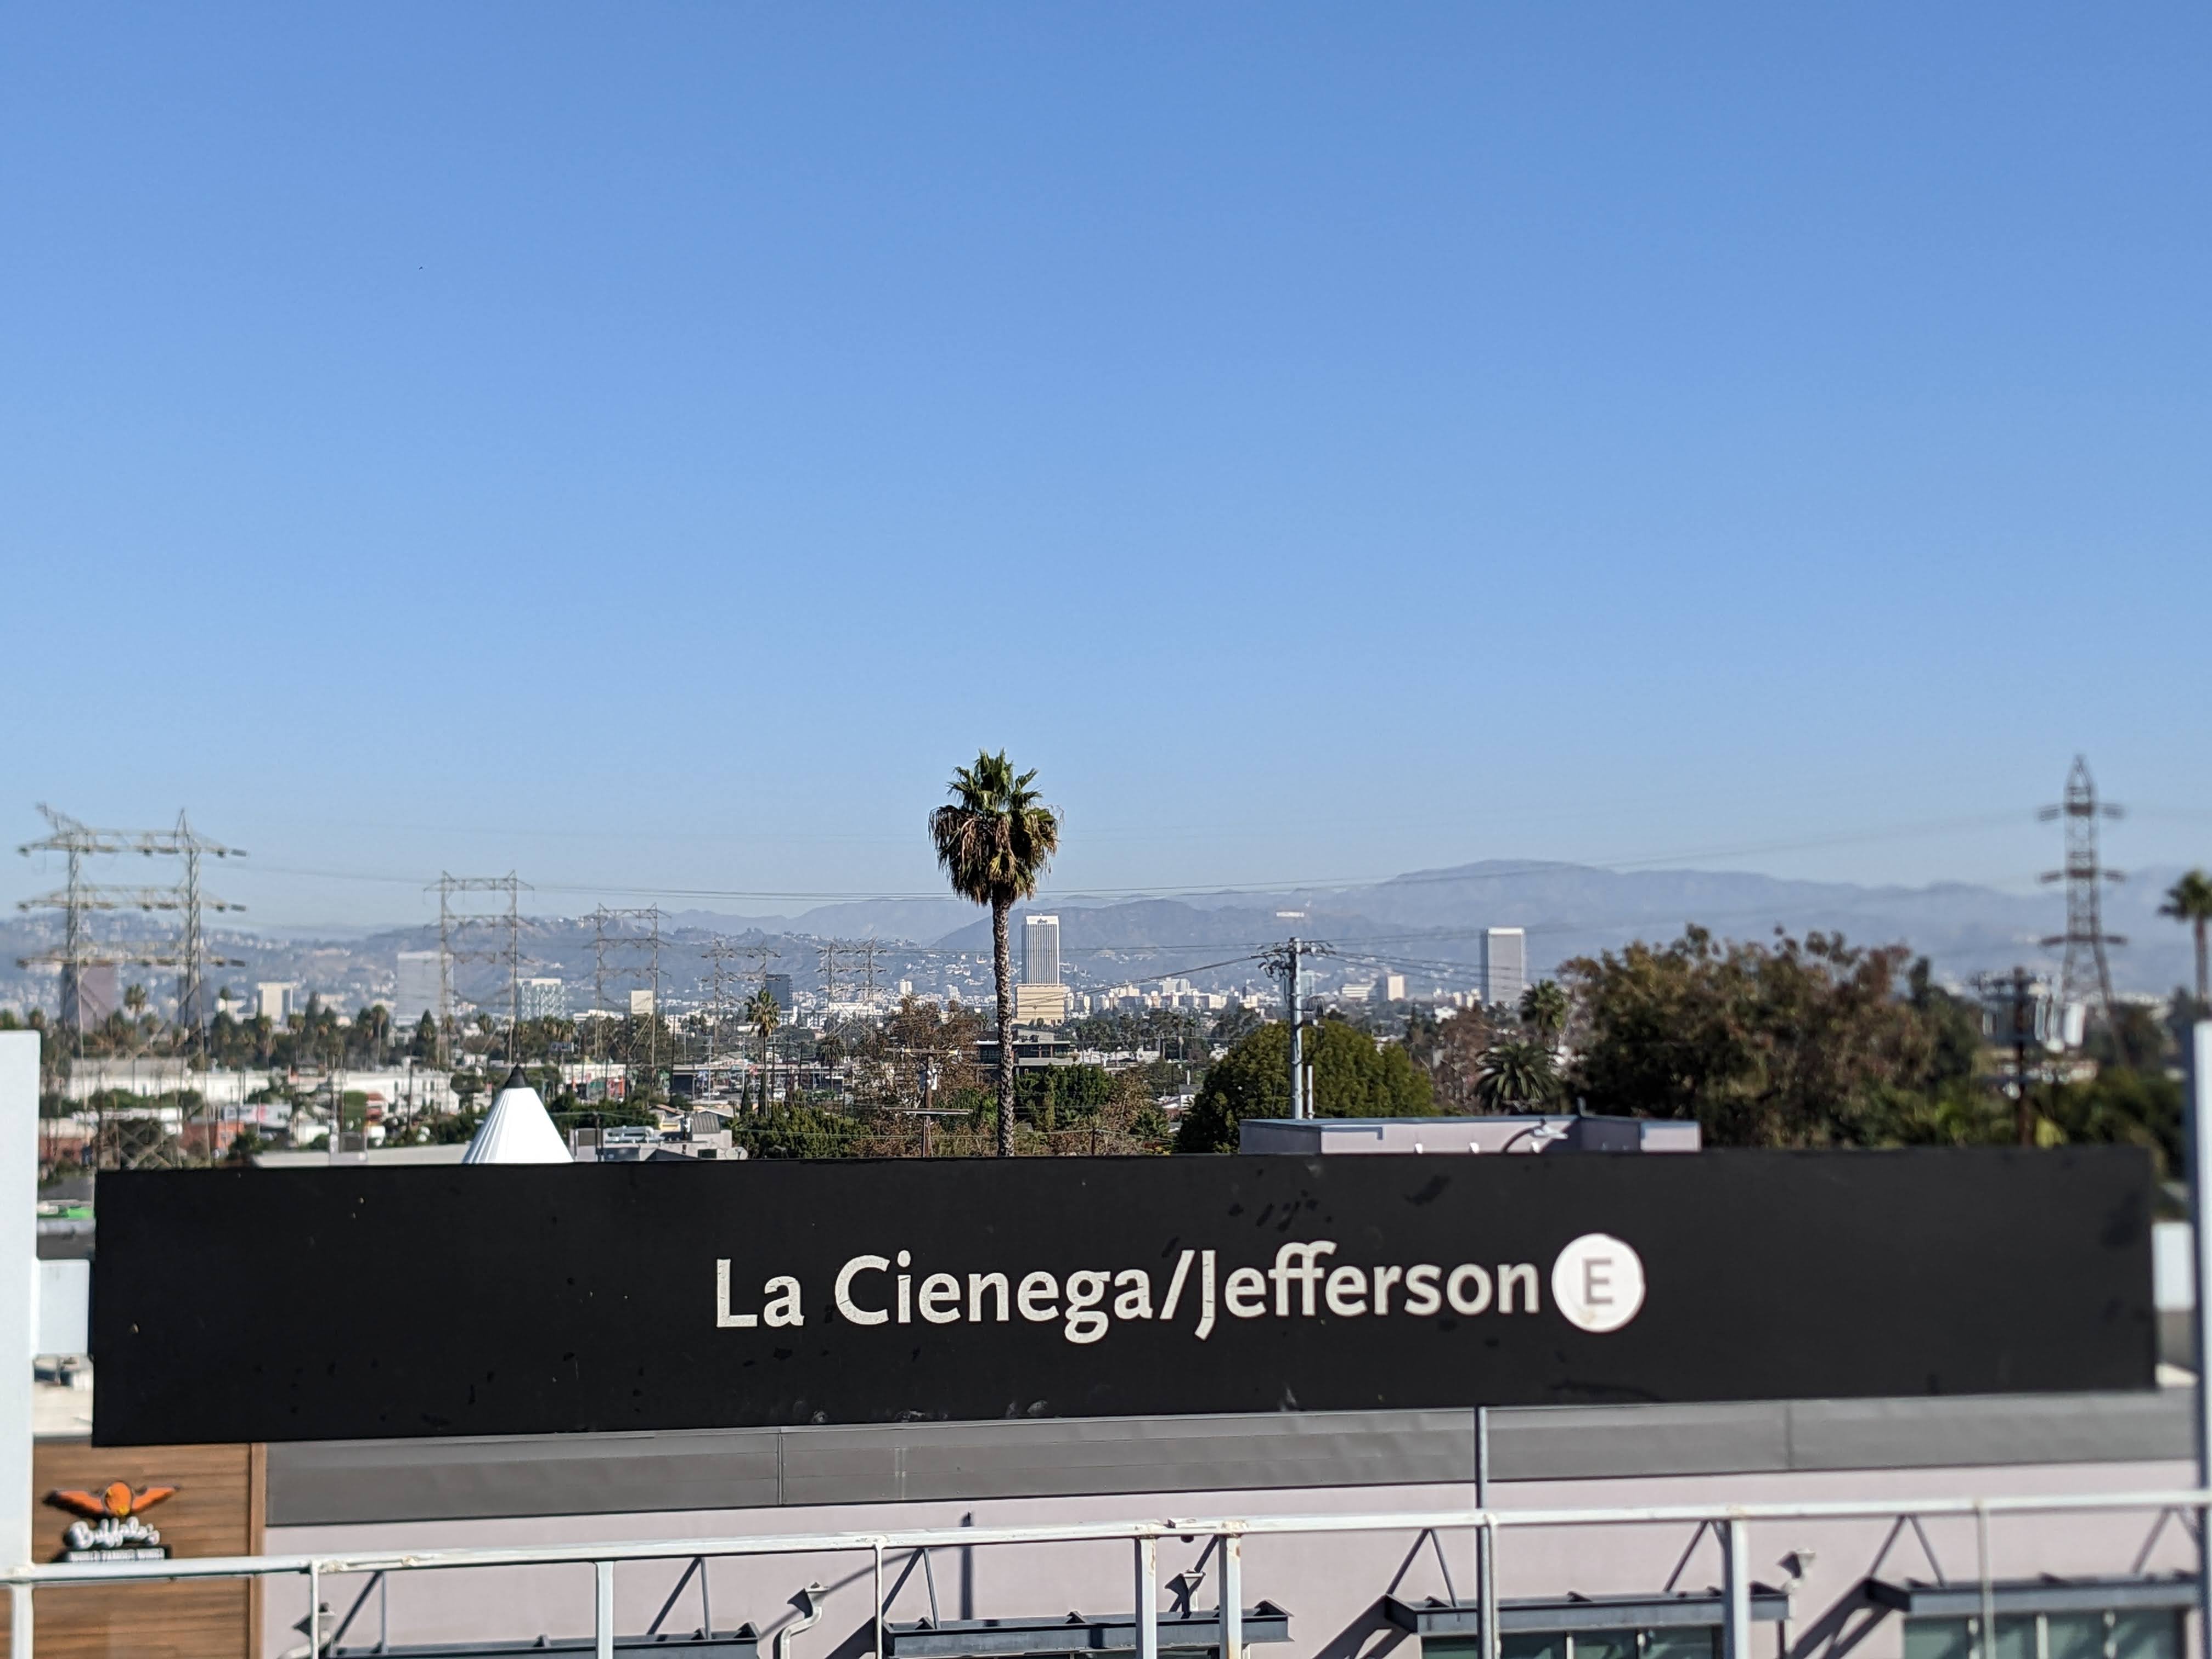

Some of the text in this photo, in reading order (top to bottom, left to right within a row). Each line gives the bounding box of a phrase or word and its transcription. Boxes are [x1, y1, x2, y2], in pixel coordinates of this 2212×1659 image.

[716, 1240, 1614, 1344] La Cienega/Jefferson E
